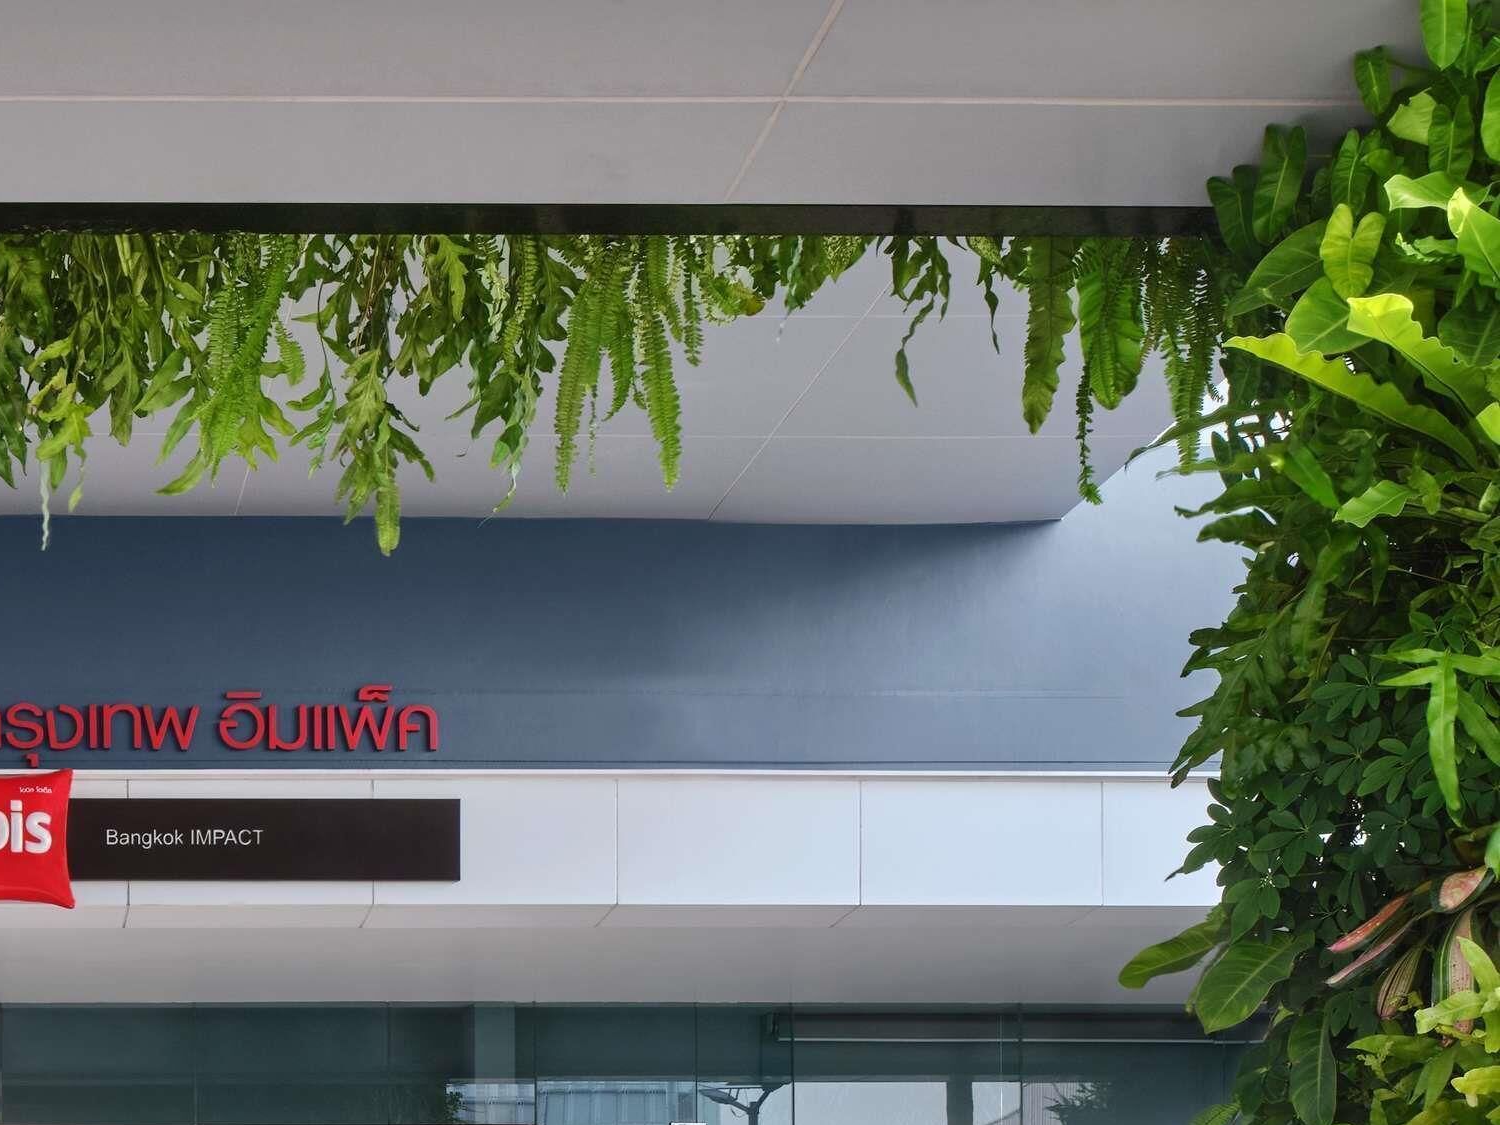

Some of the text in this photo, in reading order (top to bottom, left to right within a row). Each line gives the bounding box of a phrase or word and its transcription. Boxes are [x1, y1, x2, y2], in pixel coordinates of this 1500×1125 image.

[218, 684, 440, 751] อิมแพ็ค
[105, 828, 264, 849] Bangkok IMPACT
